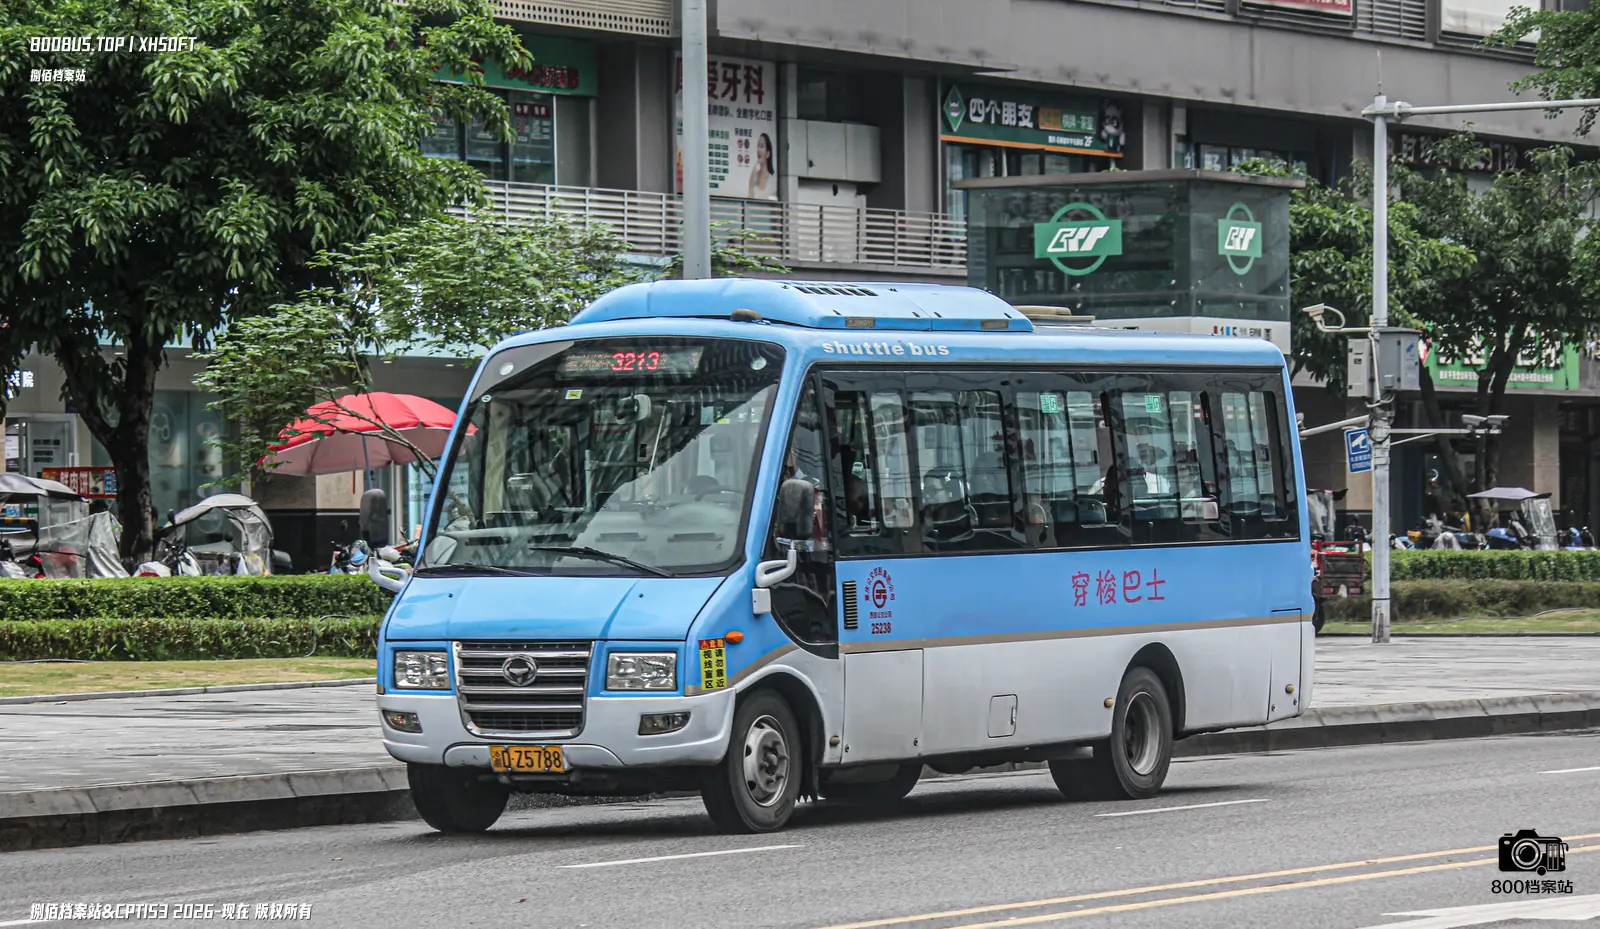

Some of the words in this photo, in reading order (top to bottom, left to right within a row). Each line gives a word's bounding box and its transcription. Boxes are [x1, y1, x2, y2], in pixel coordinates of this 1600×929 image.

[823, 340, 905, 356] shuttle
[908, 342, 951, 357] bus
[611, 351, 661, 371] 3213
[1071, 568, 1166, 607] 穿梭巴士
[871, 622, 892, 634] 25238
